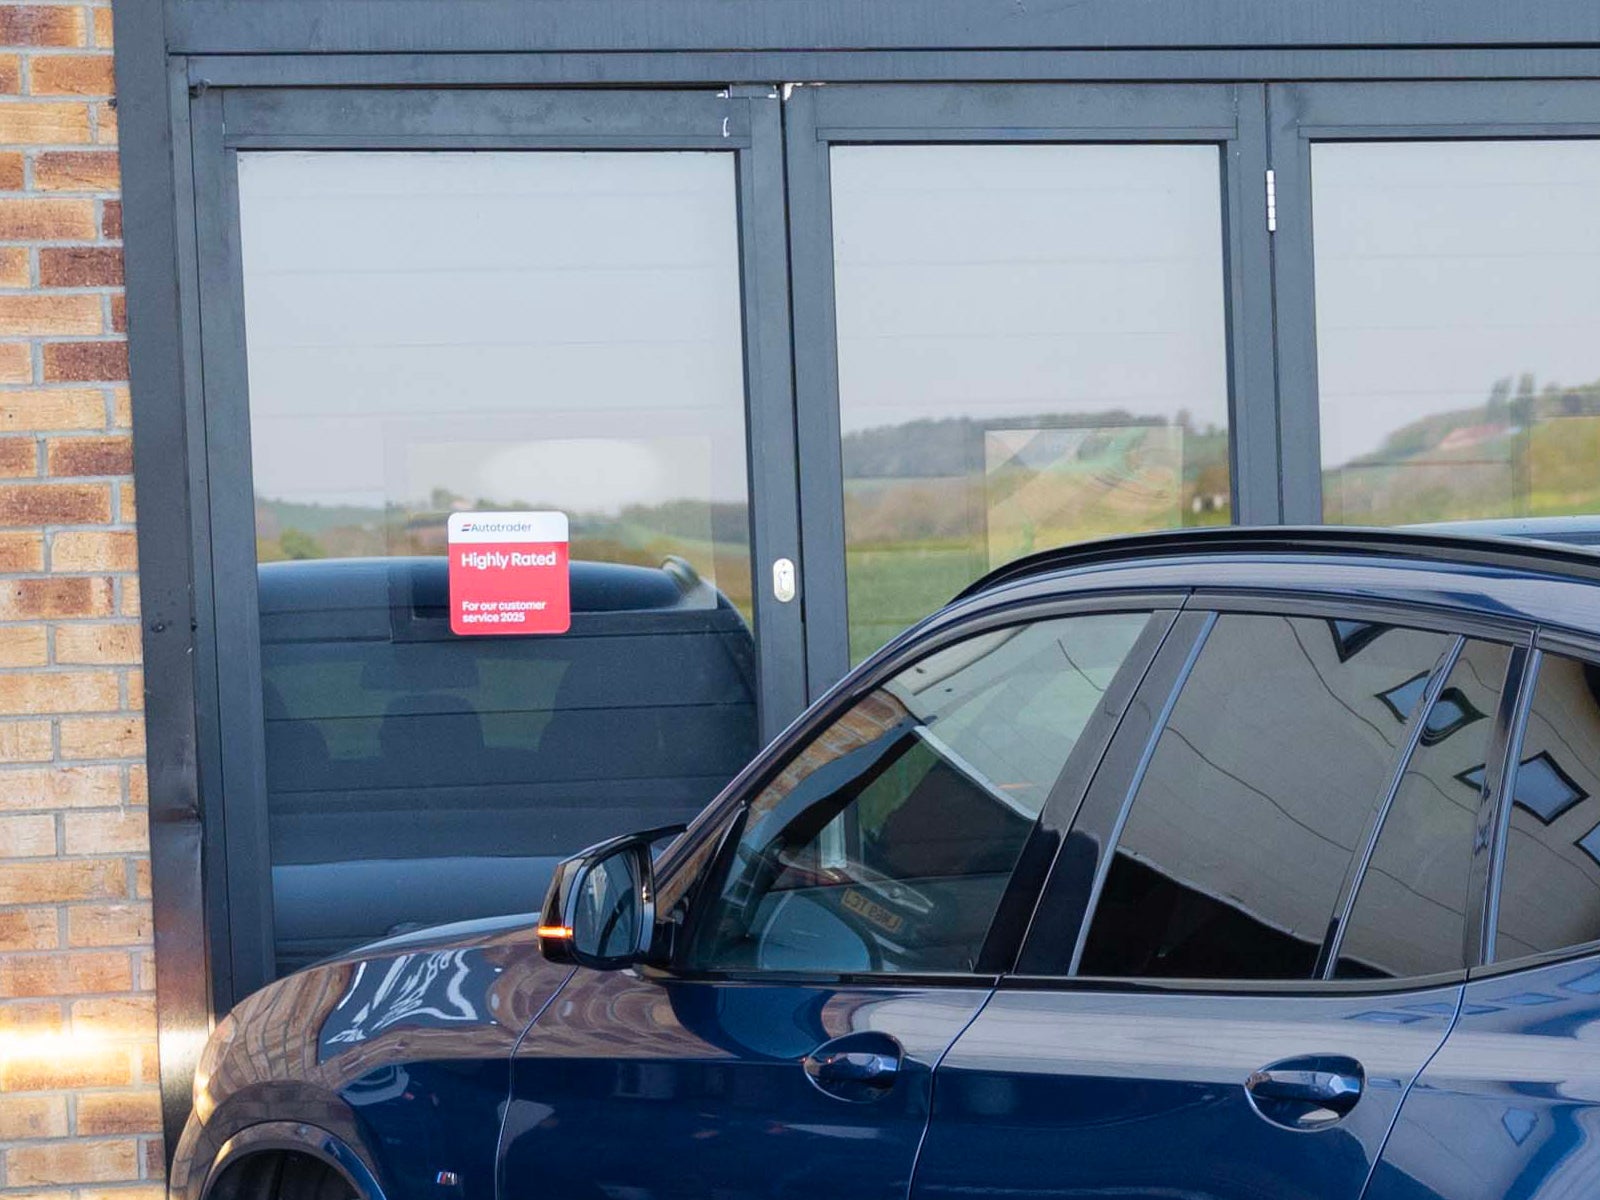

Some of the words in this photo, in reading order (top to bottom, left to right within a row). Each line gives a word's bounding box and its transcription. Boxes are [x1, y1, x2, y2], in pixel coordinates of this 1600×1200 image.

[470, 523, 532, 533] Autotrader
[461, 551, 510, 570] Highly
[511, 551, 557, 567] Rated
[462, 601, 480, 611] For
[480, 602, 498, 611] our
[498, 601, 547, 611] customer
[462, 611, 500, 623] service
[500, 611, 526, 623] 2025
